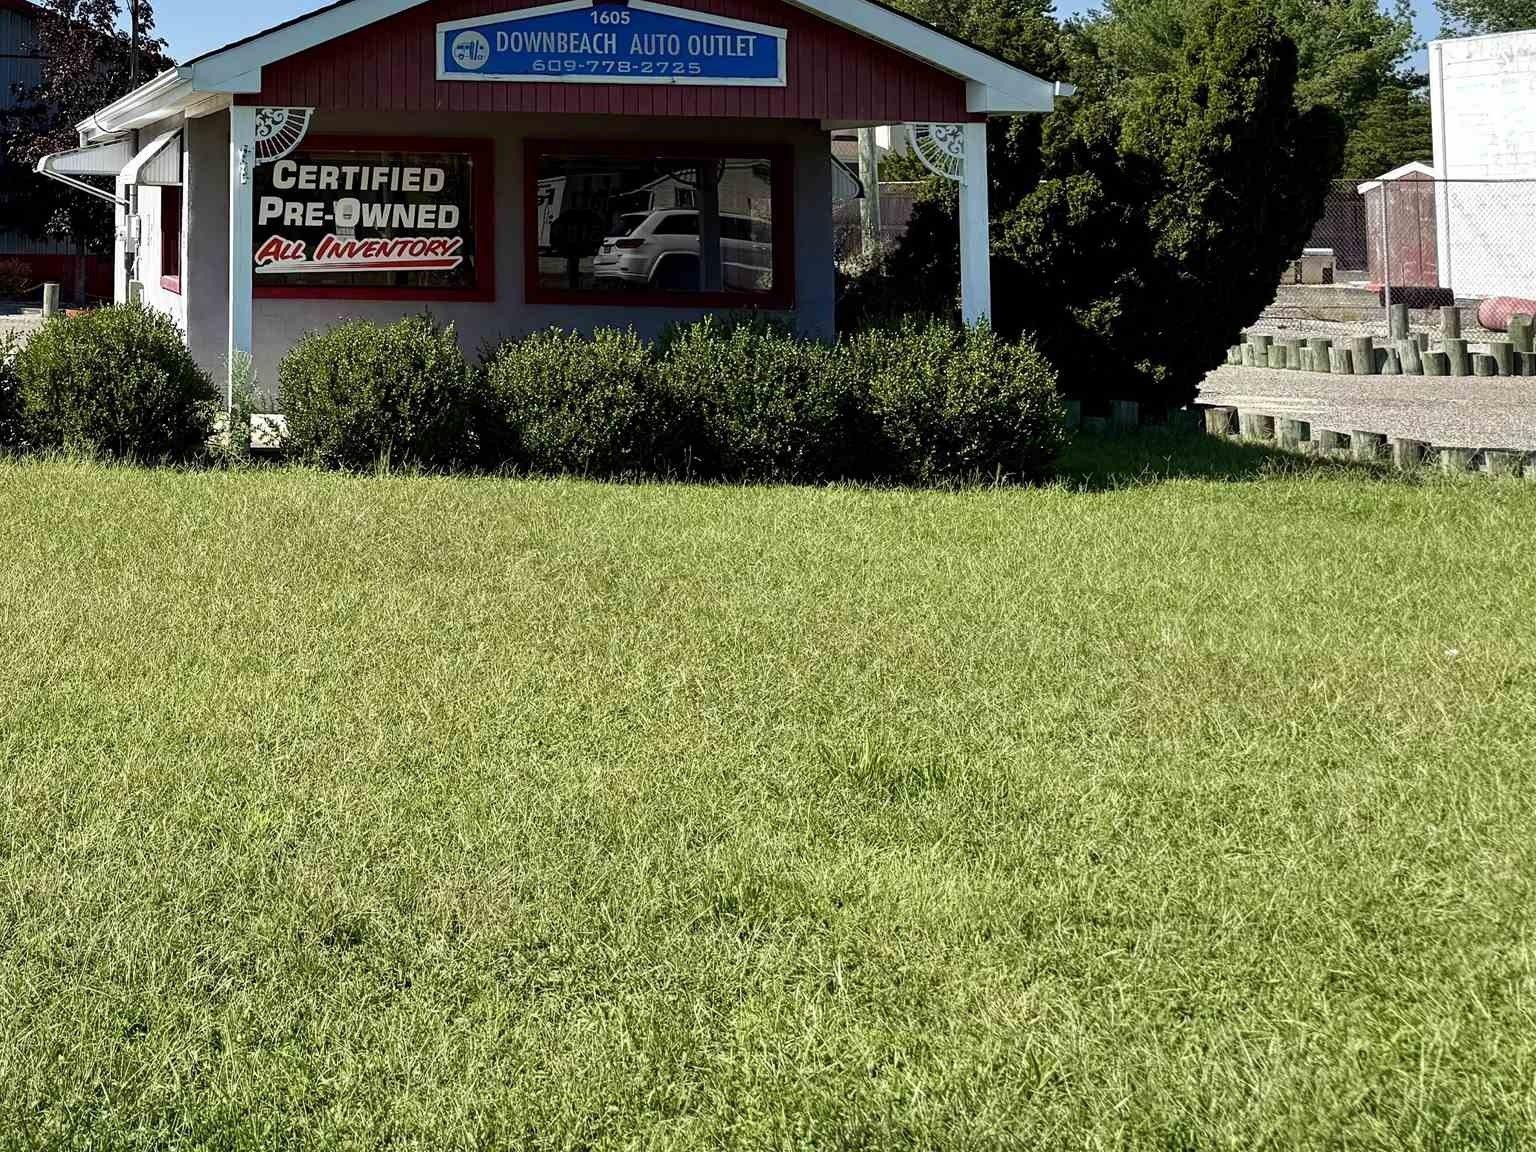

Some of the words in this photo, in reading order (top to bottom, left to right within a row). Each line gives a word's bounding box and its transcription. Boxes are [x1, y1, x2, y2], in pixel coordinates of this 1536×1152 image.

[590, 10, 631, 25] 1605
[496, 31, 617, 55] DOWNBEACH
[630, 33, 680, 56] AUTO
[688, 35, 757, 57] OUTLET
[532, 59, 702, 74] 609-778-2725
[272, 159, 445, 192] CERTIFIED
[258, 196, 460, 229] PRE-OWNED
[256, 235, 306, 264] ALL
[313, 233, 463, 261] INVENTORY
